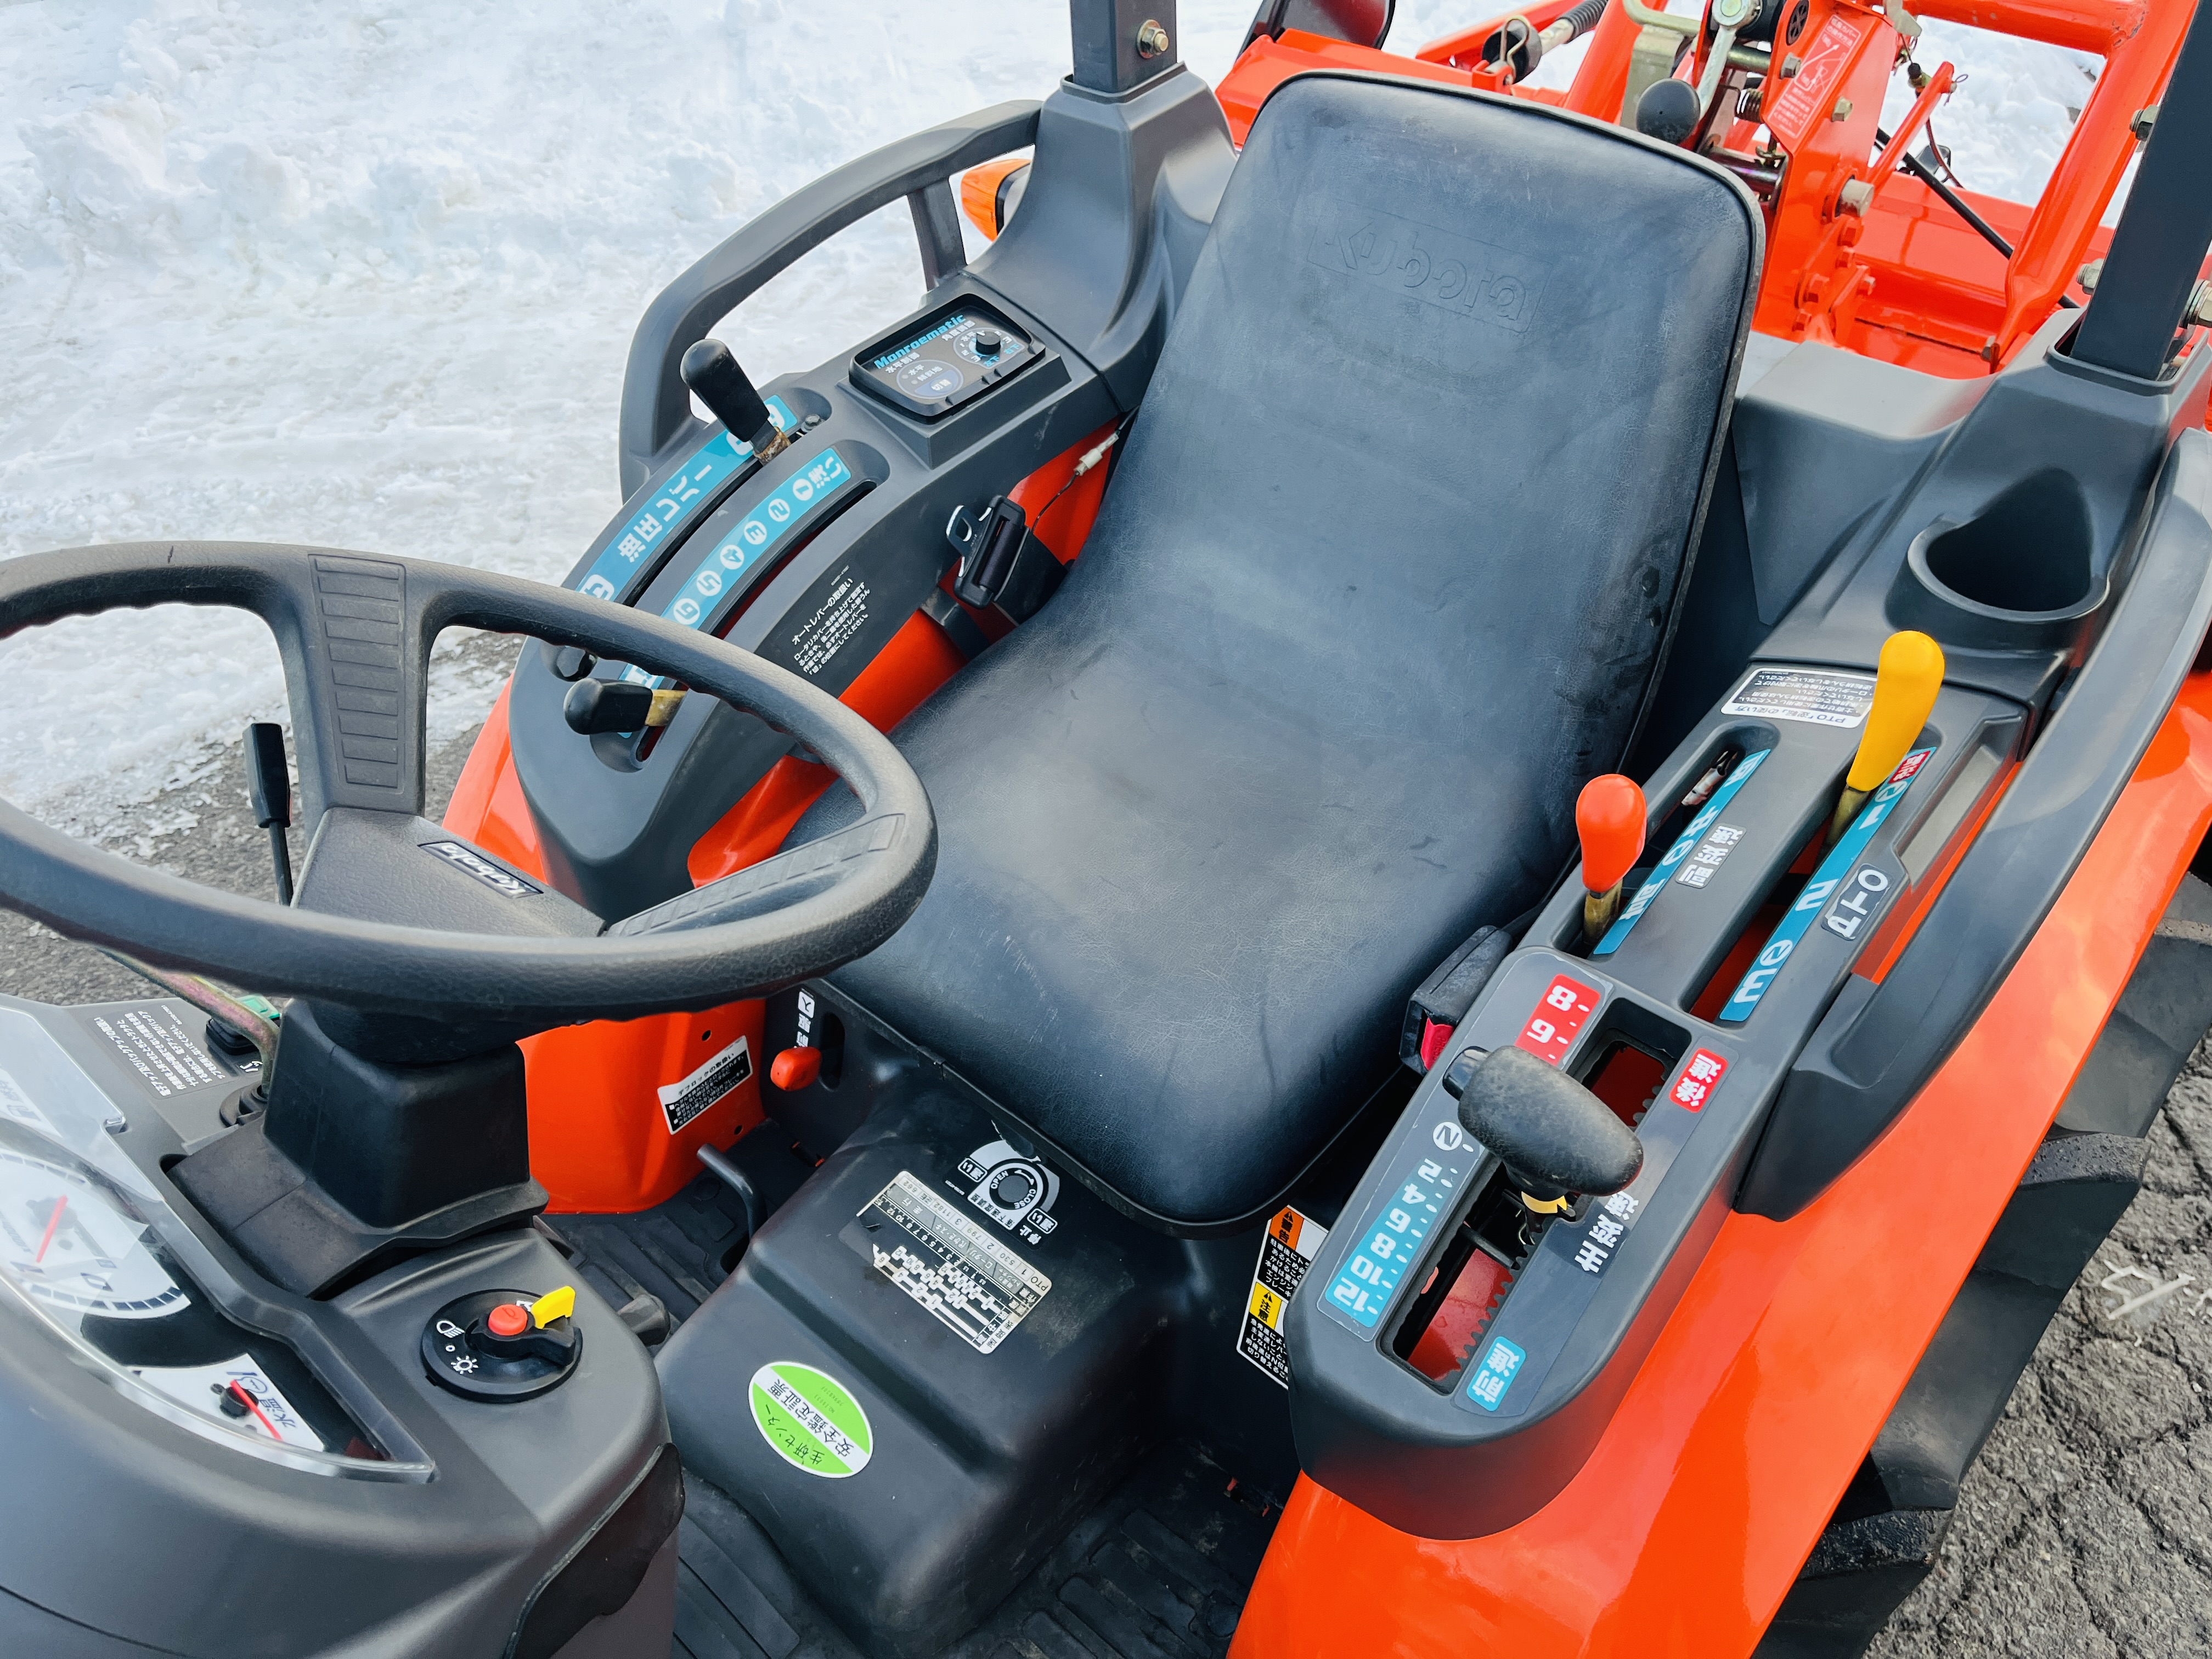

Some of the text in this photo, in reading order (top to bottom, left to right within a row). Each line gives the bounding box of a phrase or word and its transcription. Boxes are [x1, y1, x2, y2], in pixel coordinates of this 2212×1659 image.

[1323, 216, 1527, 323] Kubota
[873, 315, 966, 369] Monroematic
[908, 364, 924, 376] 水平
[808, 456, 842, 488] 浅い
[617, 465, 712, 562] 油圧レバー
[792, 578, 853, 645] オートレバーの取扱い
[1683, 806, 1719, 837] 中
[1858, 804, 1886, 830] 1
[1679, 826, 1743, 887] 副変速
[1795, 879, 1838, 911] 2
[1827, 869, 1888, 938] PTO
[1547, 984, 1578, 1011] 8
[1734, 966, 1777, 1003] 3
[1526, 1019, 1556, 1044] 6
[678, 1053, 735, 1096] デフロックの取扱い
[1674, 1053, 1722, 1108] 後進
[1435, 1124, 1460, 1149] N
[990, 1170, 1009, 1189] OPEN
[1418, 1158, 1442, 1183] 2
[903, 1180, 918, 1193] 662
[1014, 1188, 1036, 1209] CLOSE
[1402, 1183, 1426, 1204] 4
[886, 1207, 896, 1215] 12
[895, 1215, 905, 1223] 10
[933, 1202, 951, 1217] 1182
[970, 1193, 1015, 1228] 落下速度調整
[1385, 1208, 1411, 1233] 6
[967, 1228, 982, 1240] 799
[1019, 1225, 1041, 1245] 停止
[1575, 1190, 1639, 1273] 主変速
[969, 1250, 993, 1268] ロータリ
[1000, 1252, 1015, 1266] 530
[1370, 1233, 1396, 1259] 8
[1266, 1269, 1296, 1291] エンジン
[1350, 1255, 1384, 1285] 10
[1019, 1287, 1037, 1303] 作業
[1031, 1276, 1049, 1291] PTO
[1333, 1277, 1369, 1313] 12
[1258, 1299, 1272, 1323] 注意
[1472, 1341, 1520, 1402] 前進
[258, 1396, 296, 1429] 水温
[768, 1379, 854, 1457] 安全鑑定証票
[765, 1404, 825, 1465] 生研センター
